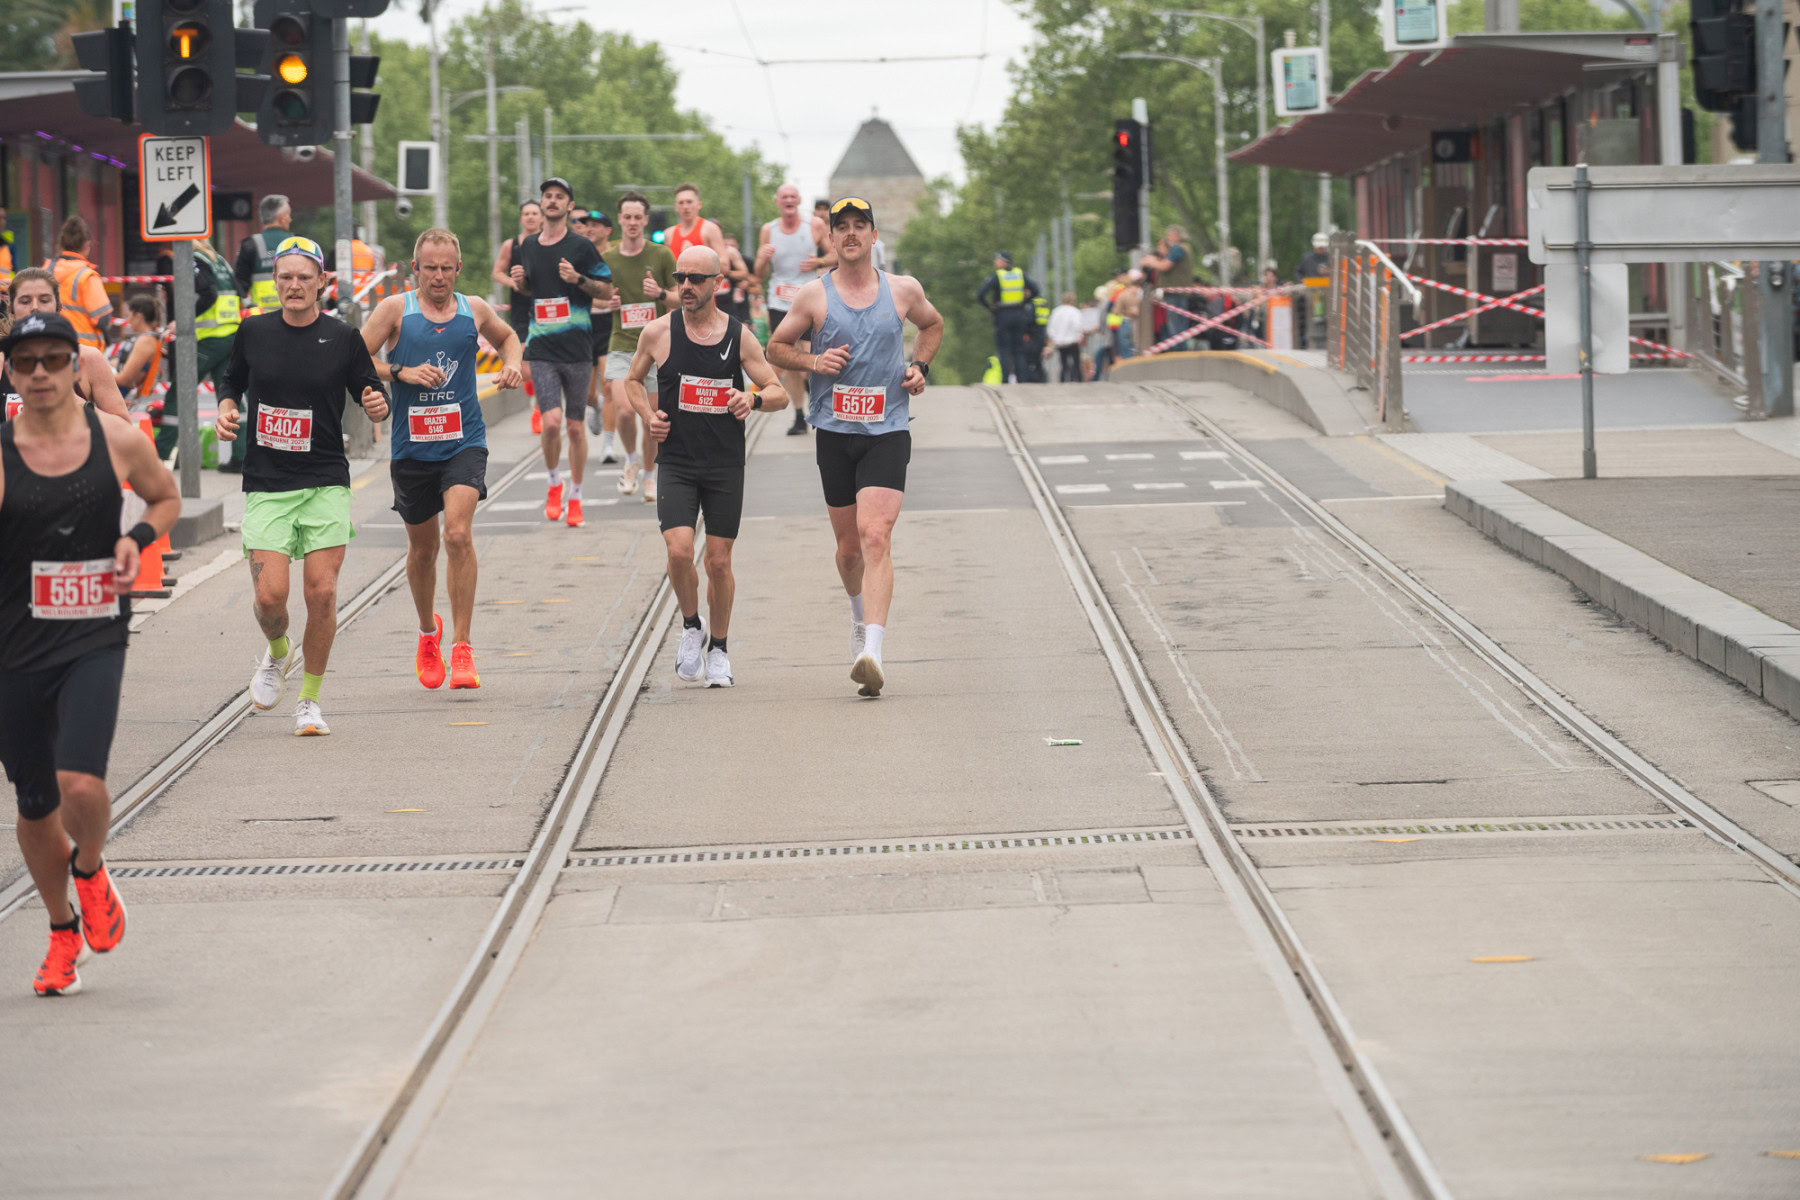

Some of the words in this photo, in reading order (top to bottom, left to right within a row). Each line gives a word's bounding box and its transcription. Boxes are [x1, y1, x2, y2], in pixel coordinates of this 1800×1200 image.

[155, 146, 196, 161] KEEP
[157, 166, 194, 182] LEFT
[419, 391, 455, 402] BTRC
[696, 387, 719, 397] MARTIN
[698, 396, 713, 406] 5122
[842, 395, 875, 414] 5512
[424, 416, 447, 425] GRAZER
[836, 413, 865, 421] MELBOURNE
[265, 416, 302, 437] 5404
[428, 425, 443, 434] 5148
[260, 434, 289, 444] MELBOURNE
[50, 575, 102, 605] 5515
